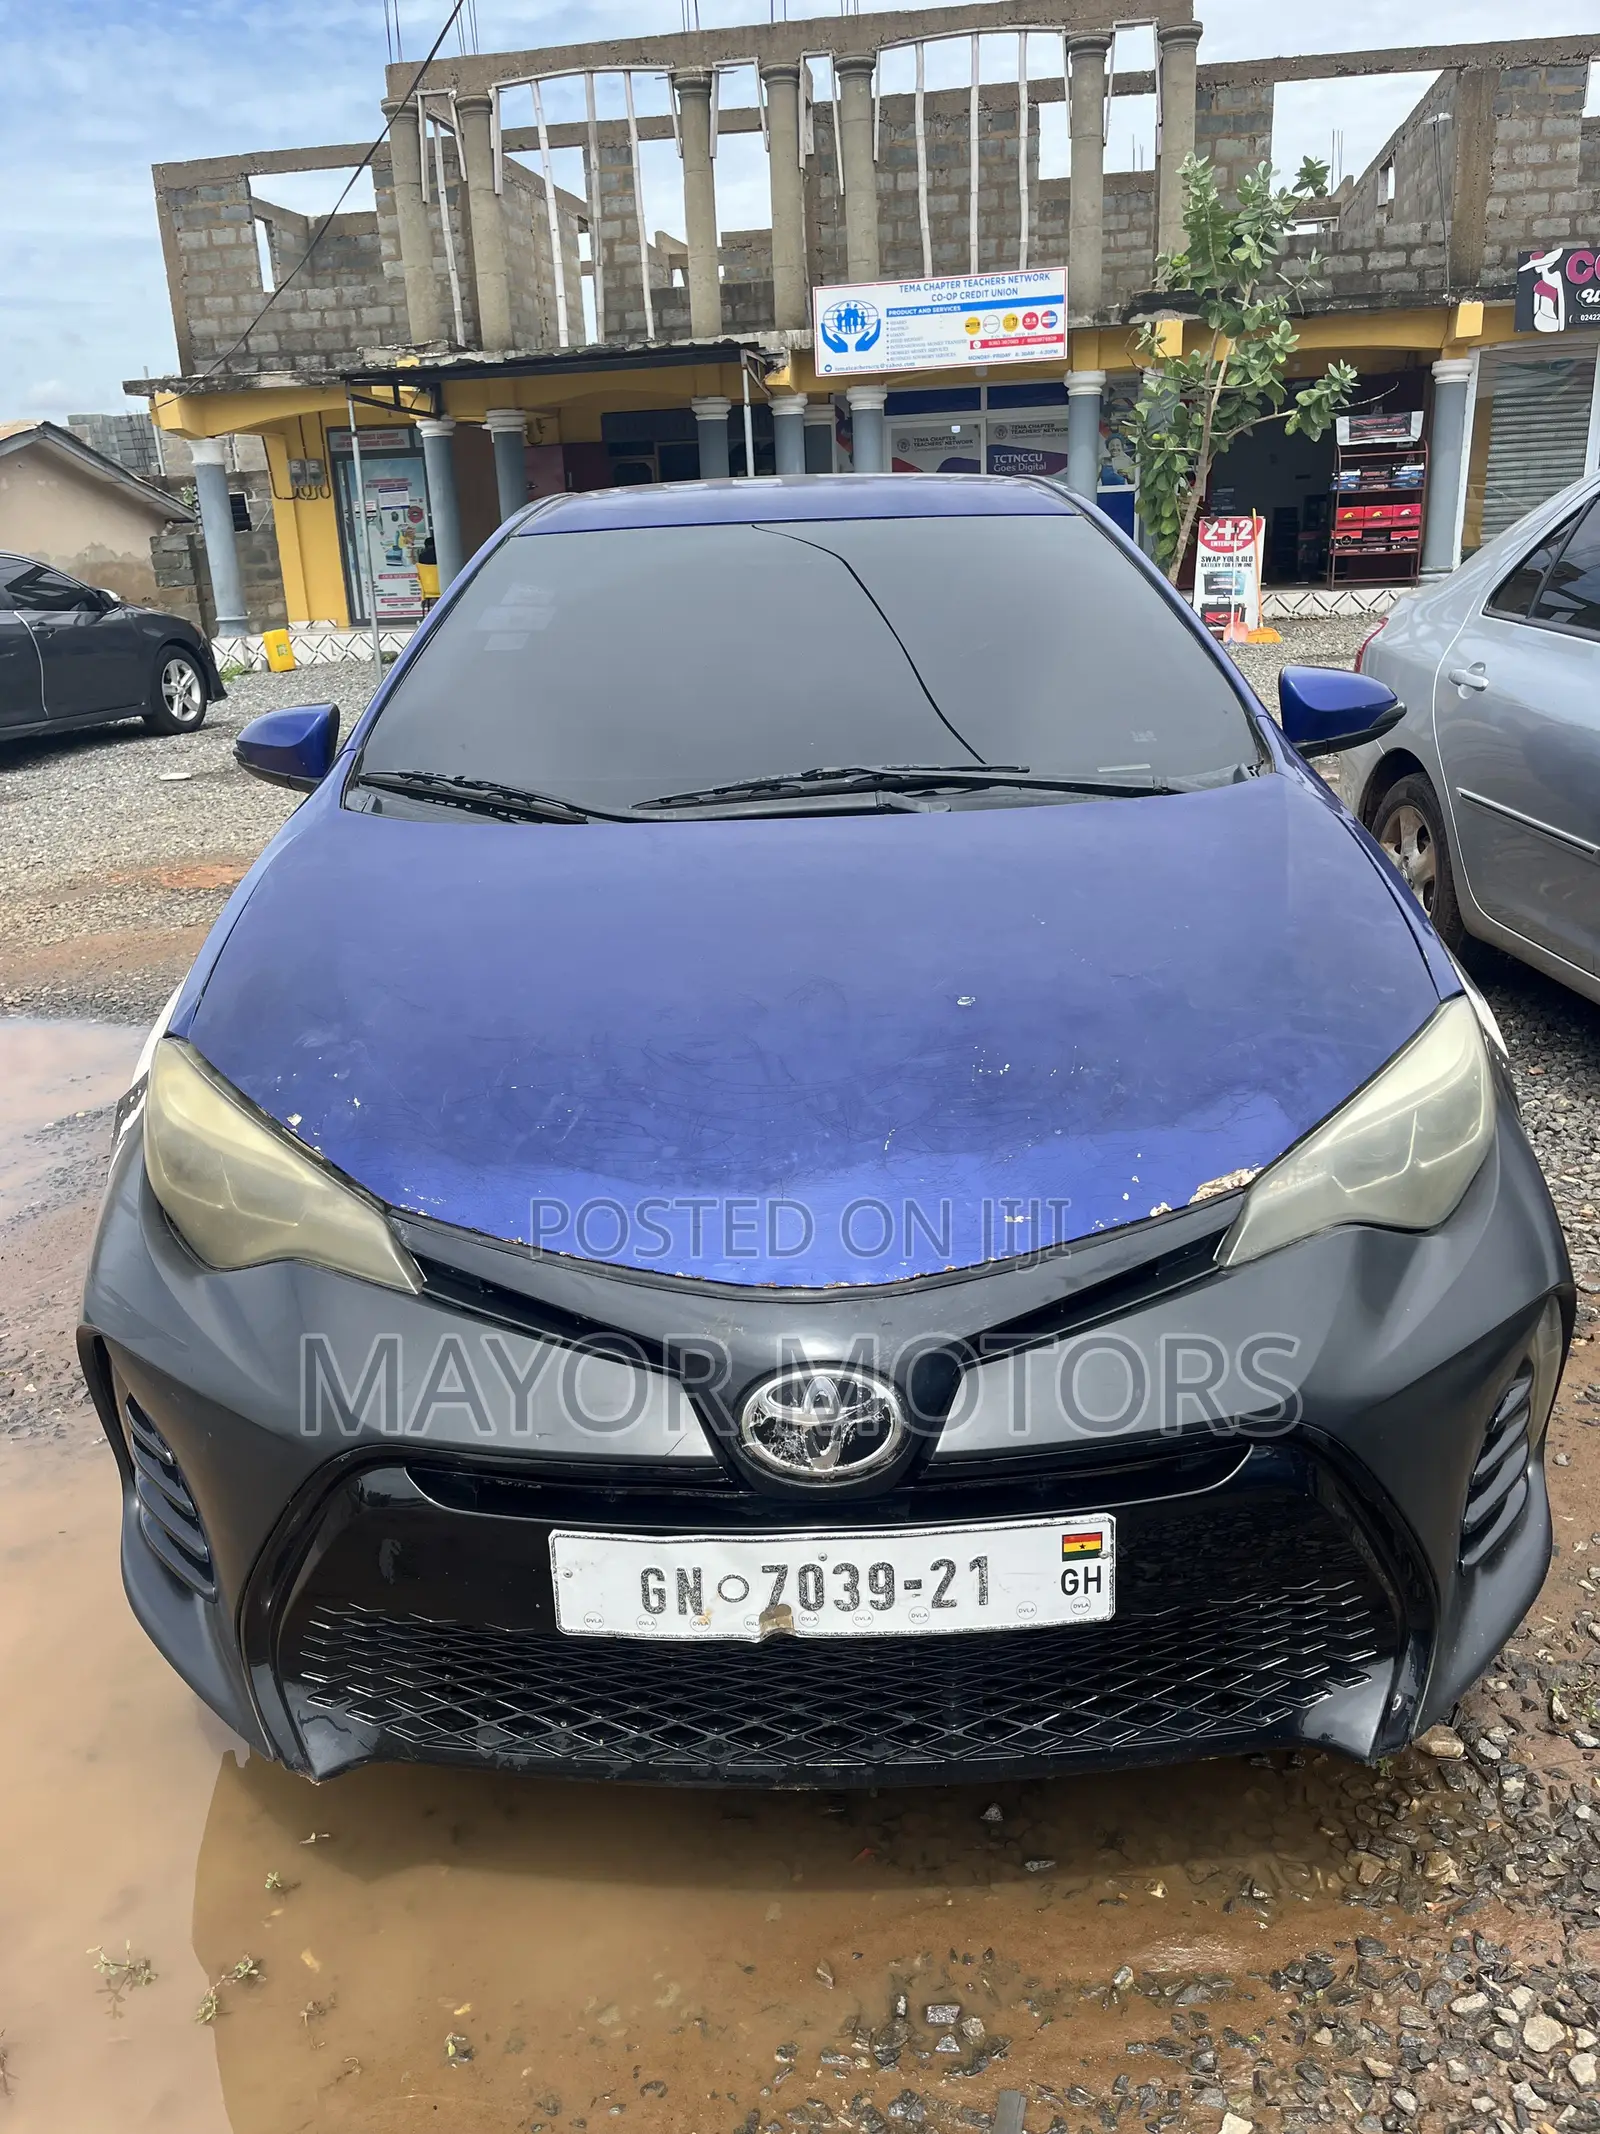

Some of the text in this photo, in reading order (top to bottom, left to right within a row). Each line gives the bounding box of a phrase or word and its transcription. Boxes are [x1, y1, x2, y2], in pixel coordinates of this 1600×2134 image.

[1565, 250, 1600, 285] C
[899, 272, 1051, 294] TEMA CHAPTER TEACHERS NETWORK
[931, 286, 1019, 303] CO-OP CREDIT UNION
[888, 305, 961, 316] PRODUCT AND SERVICES
[993, 462, 1047, 473] Goes Digital
[994, 453, 1043, 464] TCTNCCU
[1204, 519, 1253, 541] 2+2
[640, 1555, 989, 1616] GN 7039-21
[1060, 1565, 1102, 1596] GH
